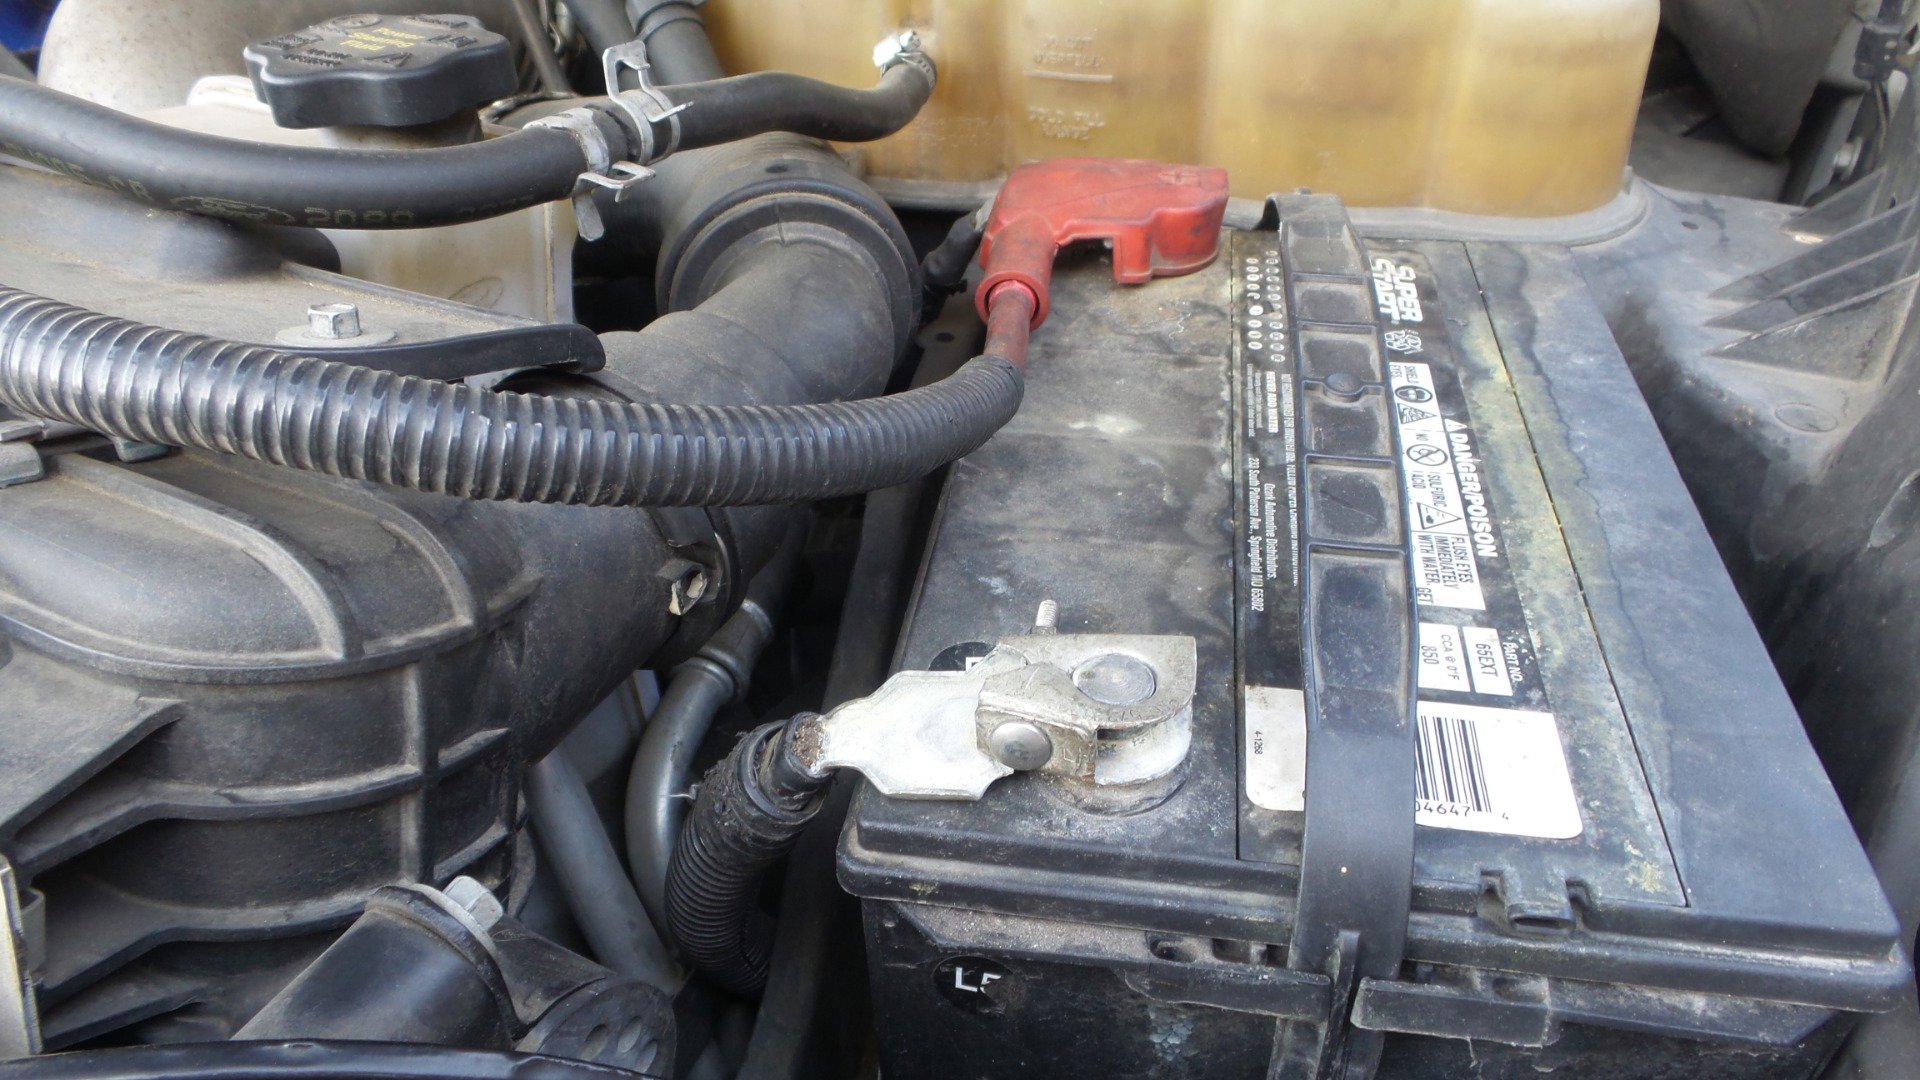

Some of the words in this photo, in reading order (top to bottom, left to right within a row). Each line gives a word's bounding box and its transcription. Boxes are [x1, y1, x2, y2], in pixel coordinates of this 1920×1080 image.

[1369, 256, 1400, 321] START
[1391, 264, 1423, 322] SUPER
[1404, 365, 1419, 383] SHIELD
[1267, 393, 1278, 408] ADD
[1268, 408, 1279, 433] WATER
[1416, 433, 1429, 441] NO
[1248, 457, 1260, 469] 233
[1248, 469, 1261, 487] South
[1411, 473, 1426, 489] ACID
[1264, 483, 1276, 501] Ozark
[1427, 473, 1447, 507] SULFURIC
[1449, 433, 1498, 557] DANGER/POISON
[1249, 487, 1261, 517] Patterson
[1265, 500, 1278, 538] Automotive
[1247, 535, 1263, 574] Springfield
[1418, 534, 1435, 554] WITH
[1451, 536, 1469, 560] FLUSH
[1421, 557, 1441, 586] WATER.
[1434, 535, 1459, 589] IMMEDIATELY
[1456, 563, 1474, 583] EYES
[1251, 575, 1263, 587] MO
[1251, 588, 1265, 612] 65802
[1416, 587, 1434, 604] GET
[1441, 634, 1454, 652] CCA
[1421, 645, 1440, 665] 850
[1444, 655, 1456, 663] @
[1475, 643, 1499, 678] 65EXT
[1254, 730, 1264, 755] 4-1268
